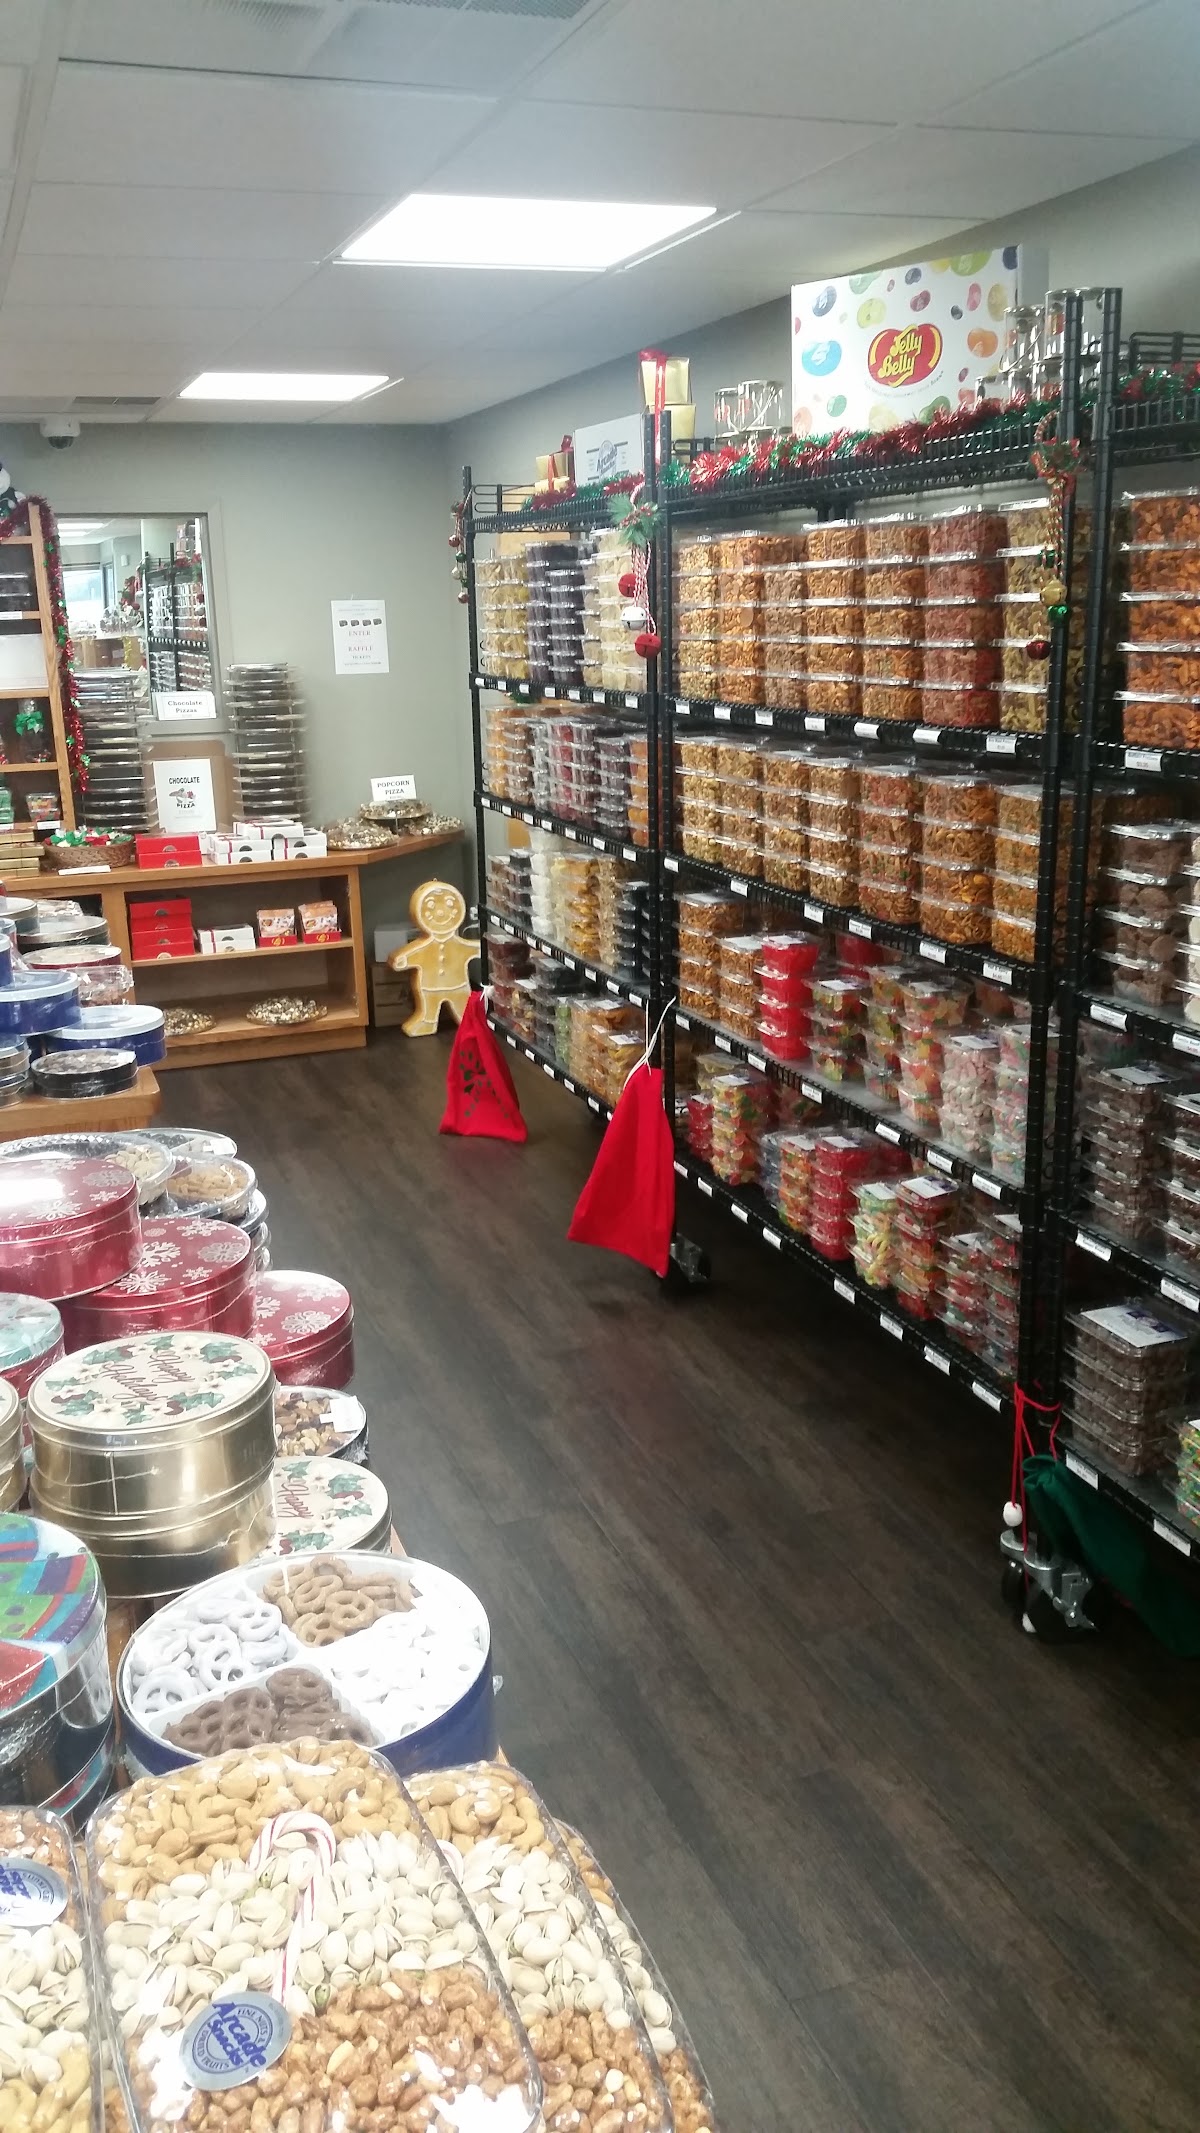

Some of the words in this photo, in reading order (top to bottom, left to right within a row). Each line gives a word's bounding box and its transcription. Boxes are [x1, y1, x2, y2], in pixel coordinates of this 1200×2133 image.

[889, 324, 922, 357] Jelly
[877, 353, 916, 388] Belly
[168, 776, 200, 785] CHOCOLATE
[376, 779, 410, 788] POPCORN
[100, 1363, 168, 1400] Holidays
[147, 1354, 195, 1383] Happy
[212, 2002, 267, 2067] Arcade
[237, 2008, 256, 2017] FINE
[258, 2014, 268, 2035] NUTS
[207, 2018, 243, 2066] Snacks
[201, 2056, 230, 2070] FRUITS
